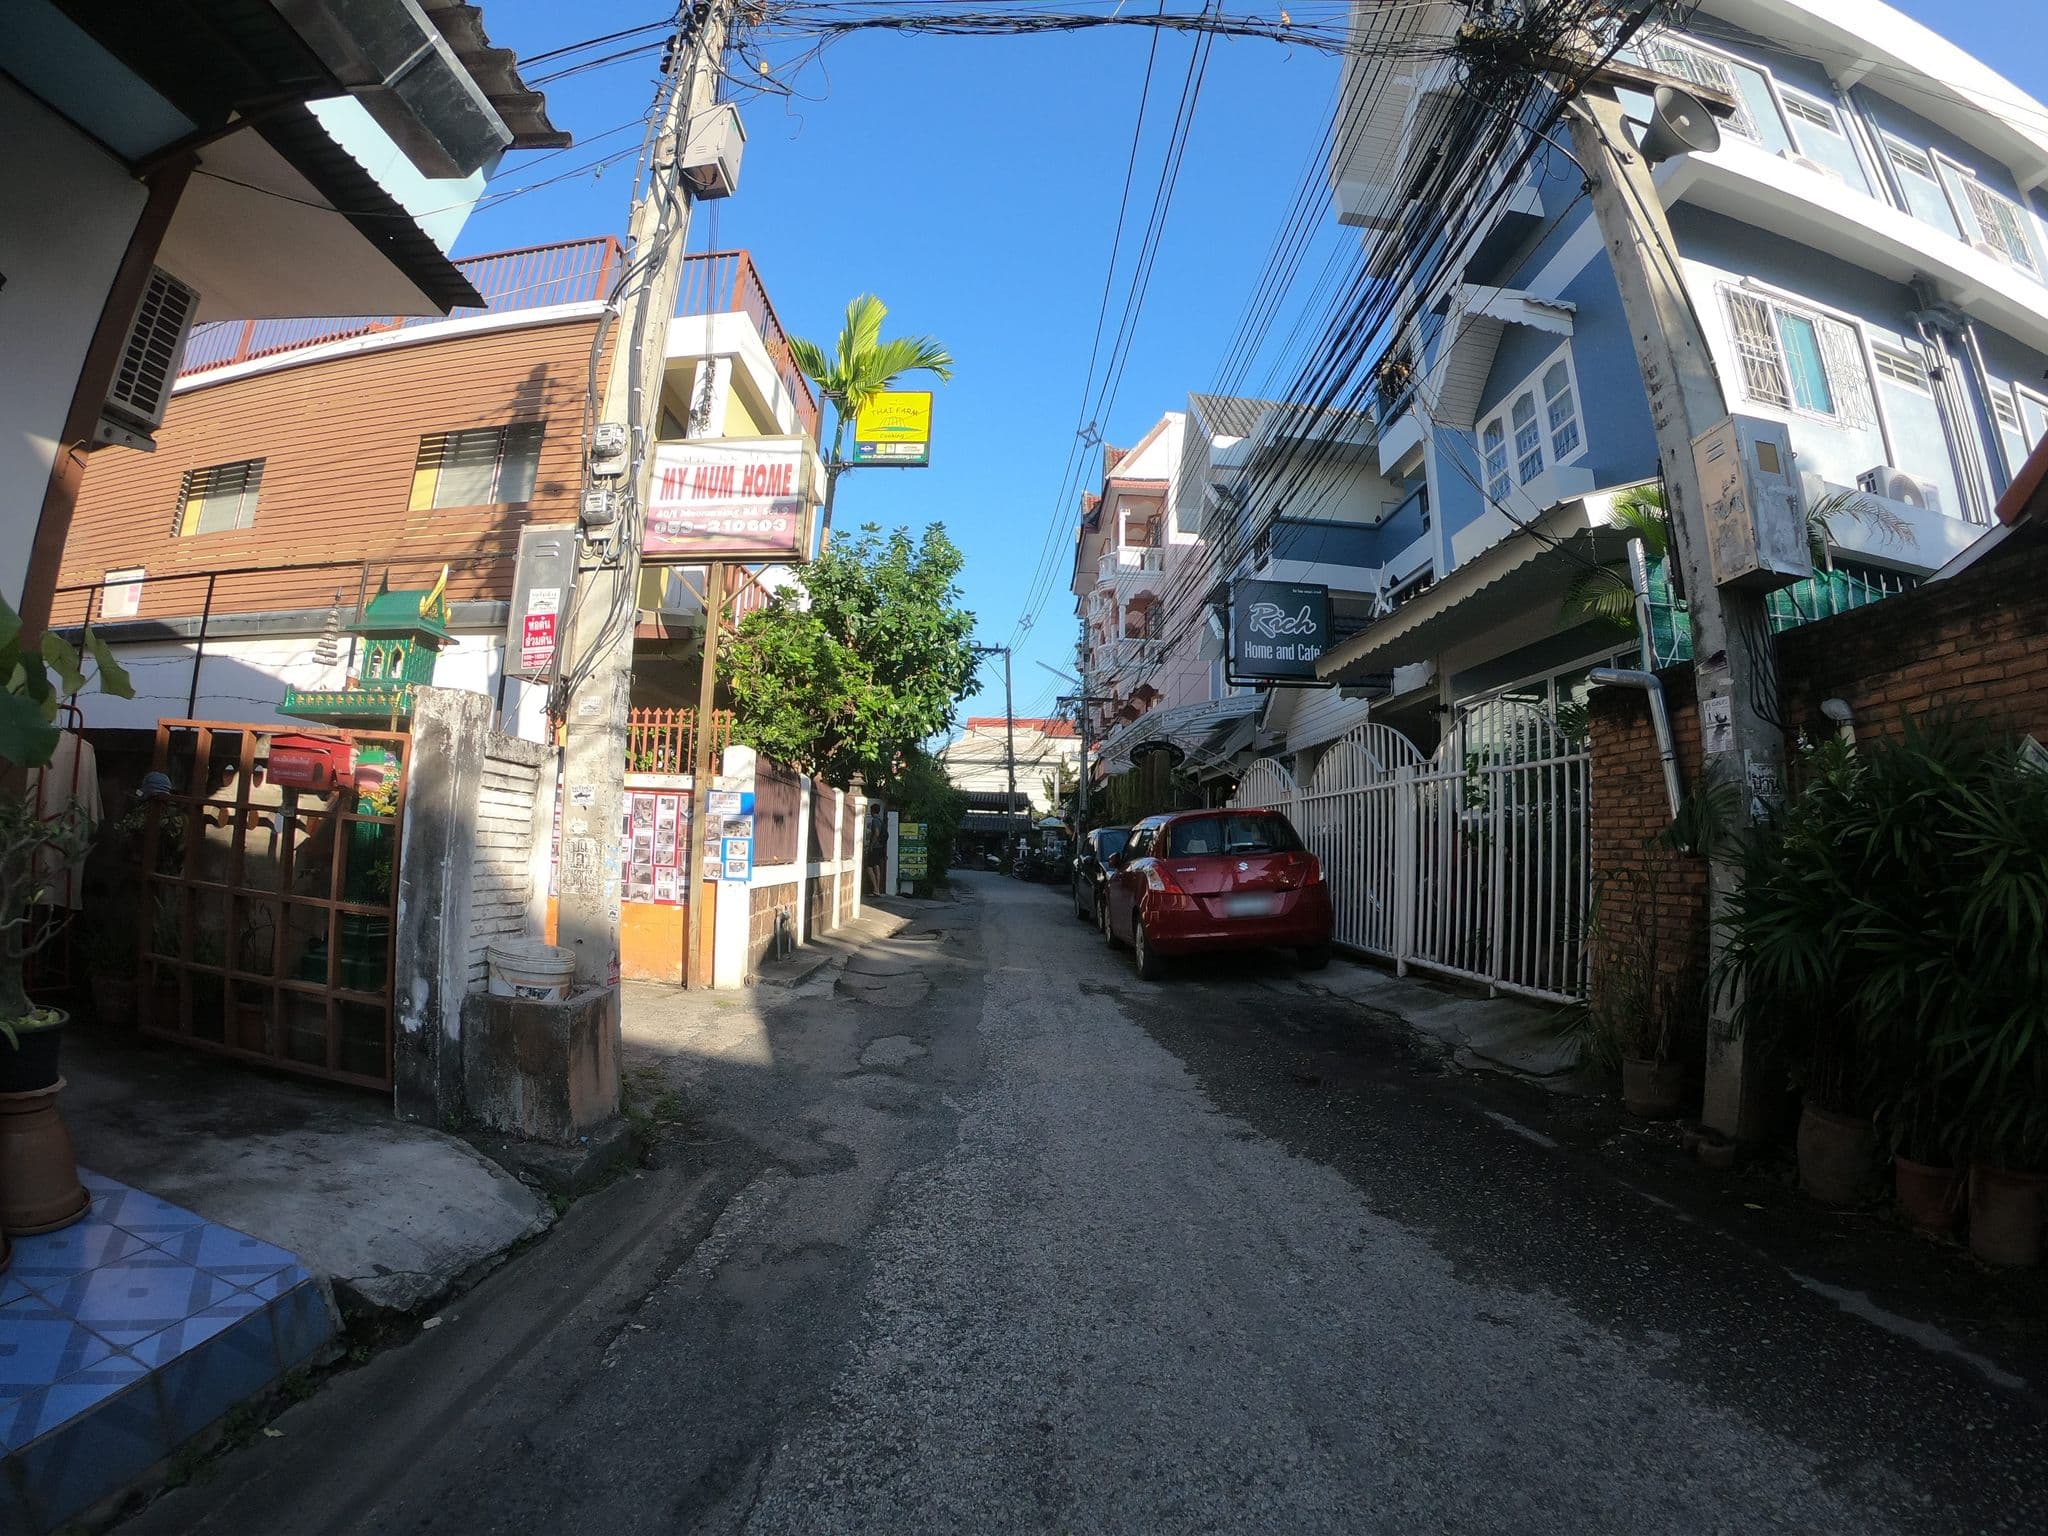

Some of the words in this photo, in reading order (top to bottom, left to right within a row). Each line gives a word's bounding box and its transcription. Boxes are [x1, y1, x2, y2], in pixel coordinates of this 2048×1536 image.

[871, 407, 893, 416] THAI
[896, 407, 919, 417] FARM
[879, 432, 905, 440] Cooking
[660, 467, 688, 500] MY
[692, 465, 735, 499] MUM
[741, 463, 793, 497] HOME
[1249, 602, 1317, 639] Rich
[1244, 641, 1273, 660] Home
[1275, 644, 1295, 661] and
